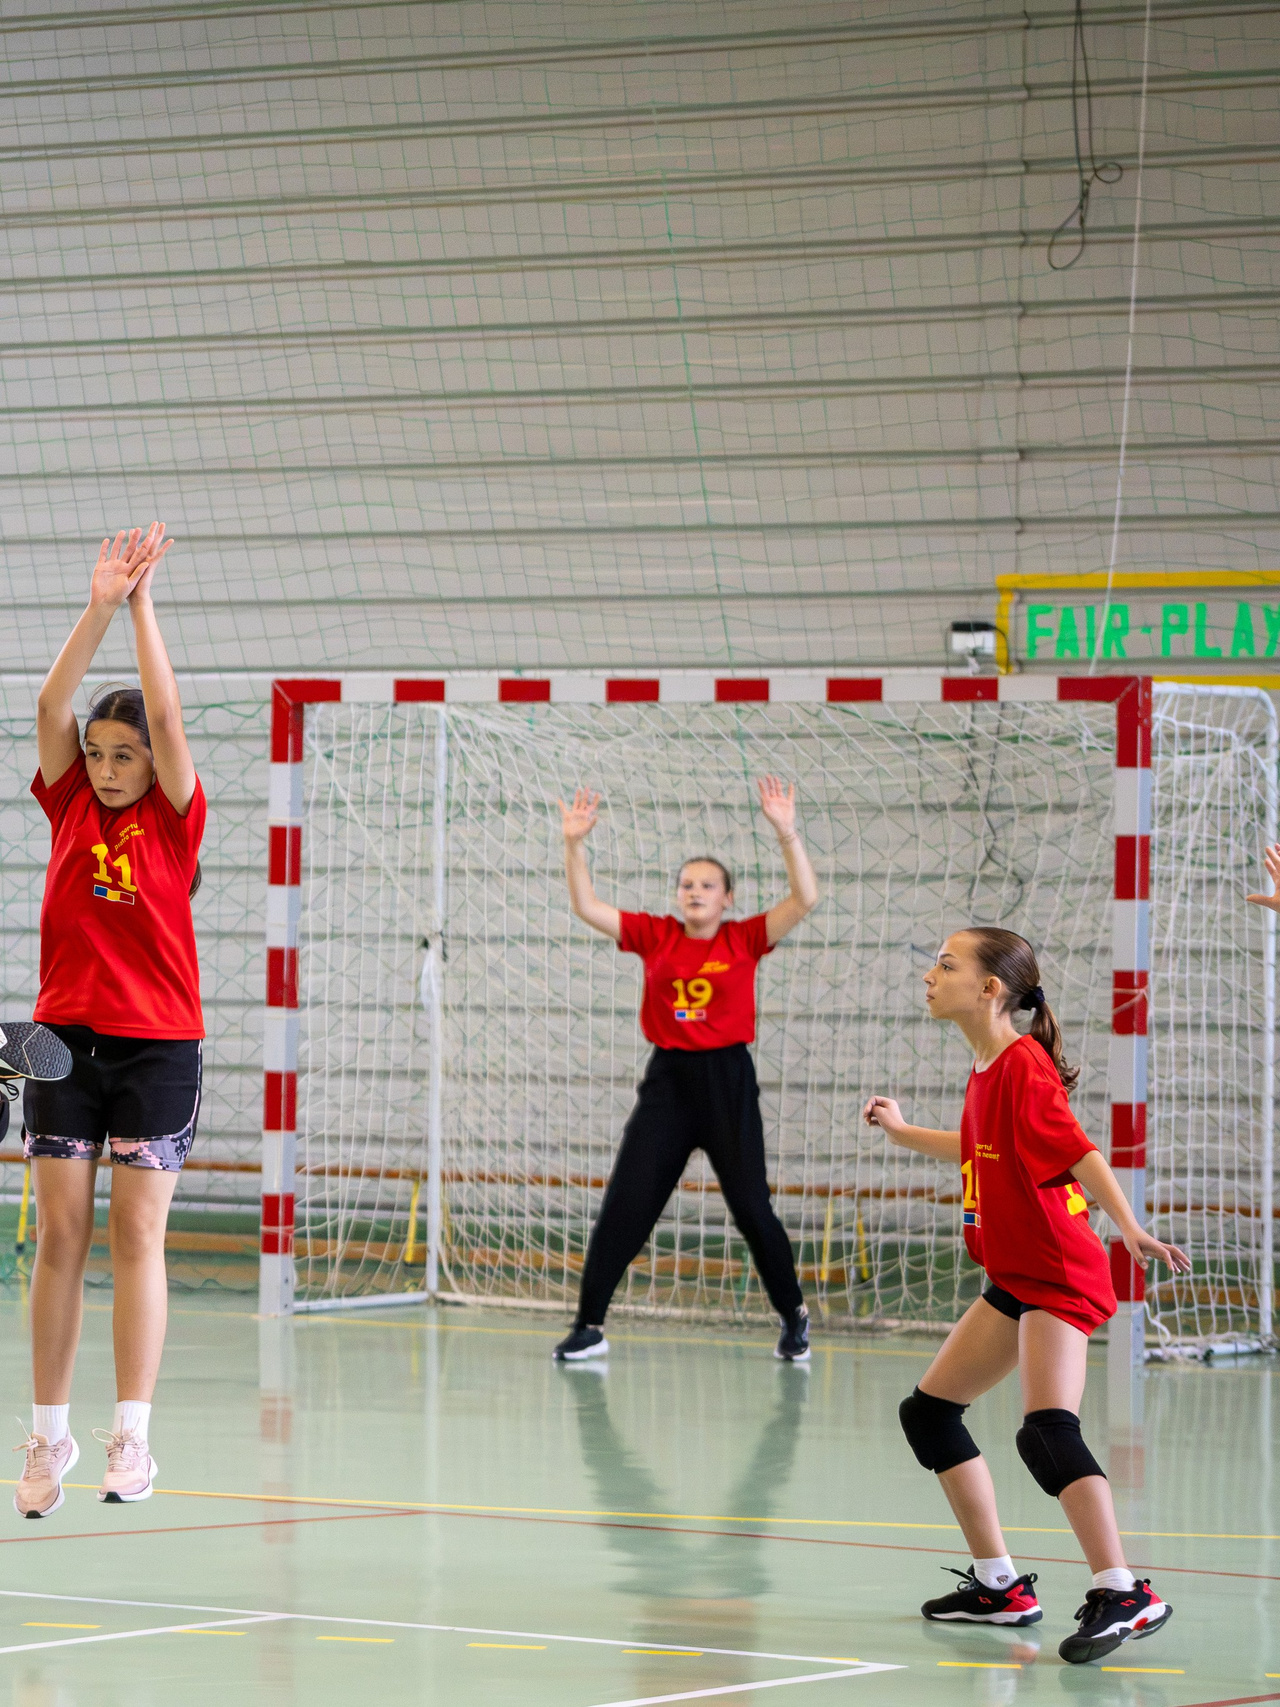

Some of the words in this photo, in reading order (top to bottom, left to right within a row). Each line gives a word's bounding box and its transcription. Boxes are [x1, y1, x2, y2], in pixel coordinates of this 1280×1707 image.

[1026, 601, 1280, 659] FAIR-PLAY
[91, 843, 138, 893] 11
[671, 977, 714, 1010] 19
